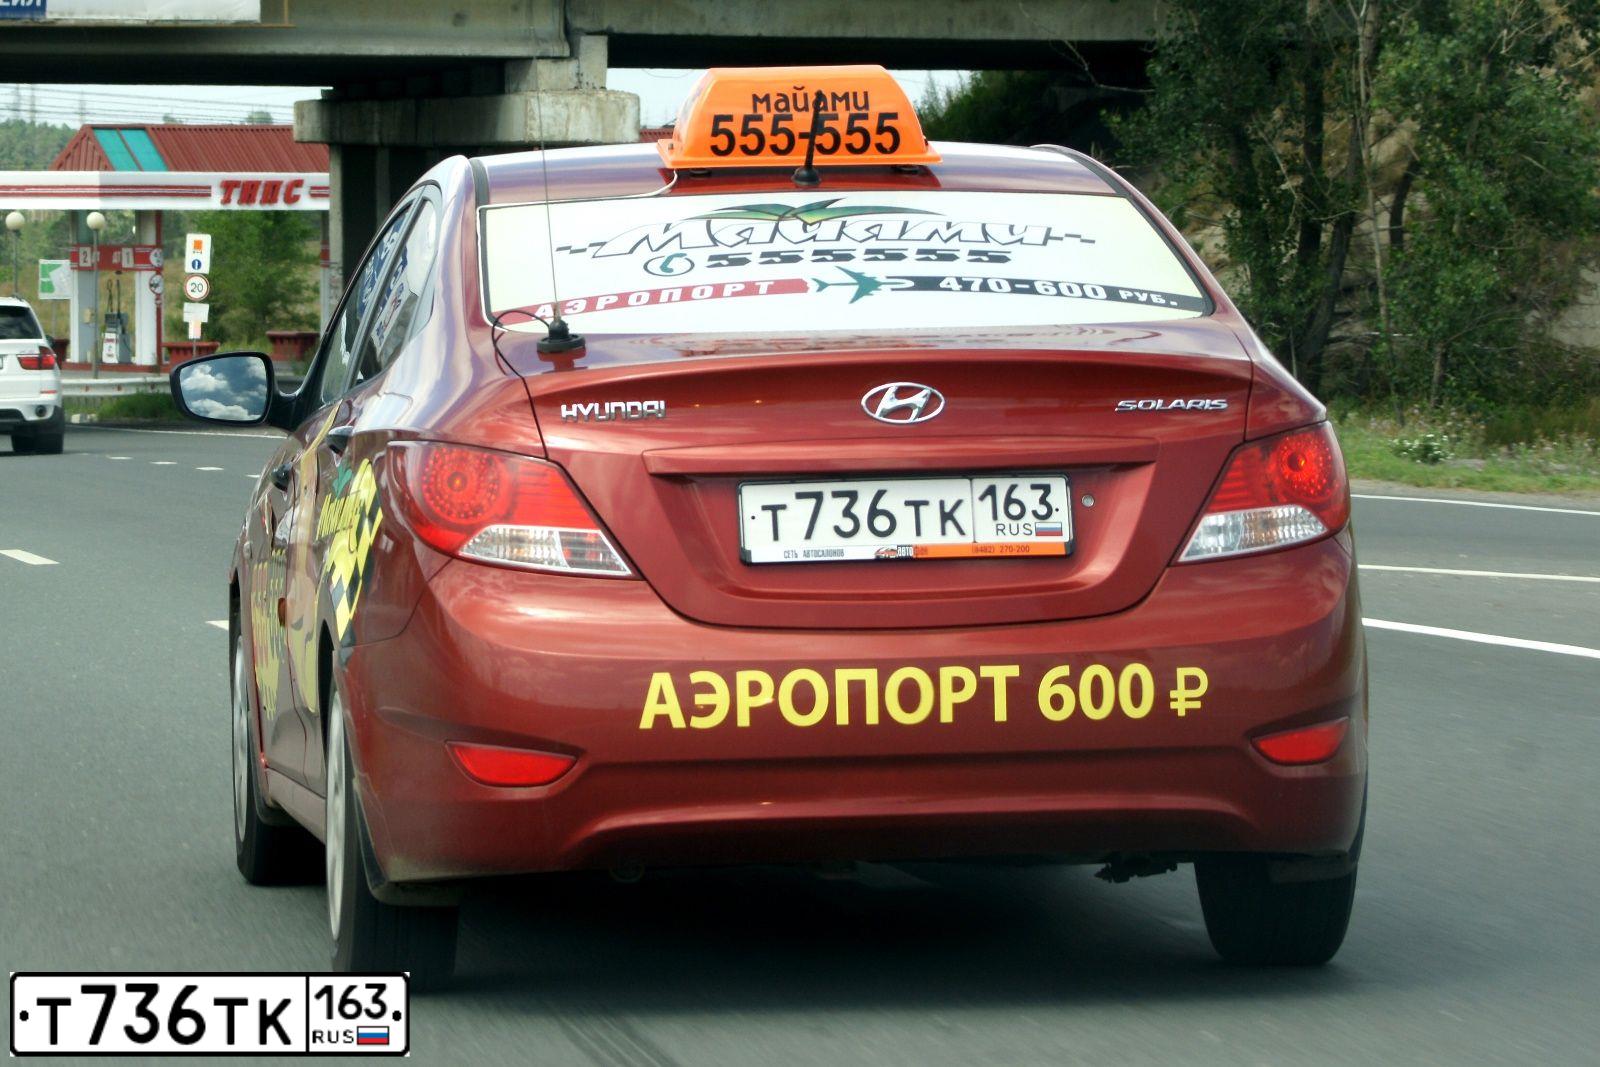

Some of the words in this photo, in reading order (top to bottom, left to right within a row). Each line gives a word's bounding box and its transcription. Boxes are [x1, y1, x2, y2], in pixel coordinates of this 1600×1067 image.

[752, 86, 869, 113] майами
[710, 112, 901, 157] 555-555
[706, 248, 1011, 269] 555555
[190, 282, 204, 293] 20
[531, 281, 776, 319] АЭРОПОРТ
[939, 276, 1107, 300] 470-600
[1119, 290, 1179, 306] РУБ.
[560, 400, 667, 421] HYUNDAI
[1115, 398, 1229, 412] SOLARIS
[760, 488, 968, 541] Т736ТК
[977, 483, 1053, 521] 163
[995, 522, 1033, 537] RUS
[638, 664, 1021, 730] АЭРОПОРТ
[1037, 662, 1156, 721] 600
